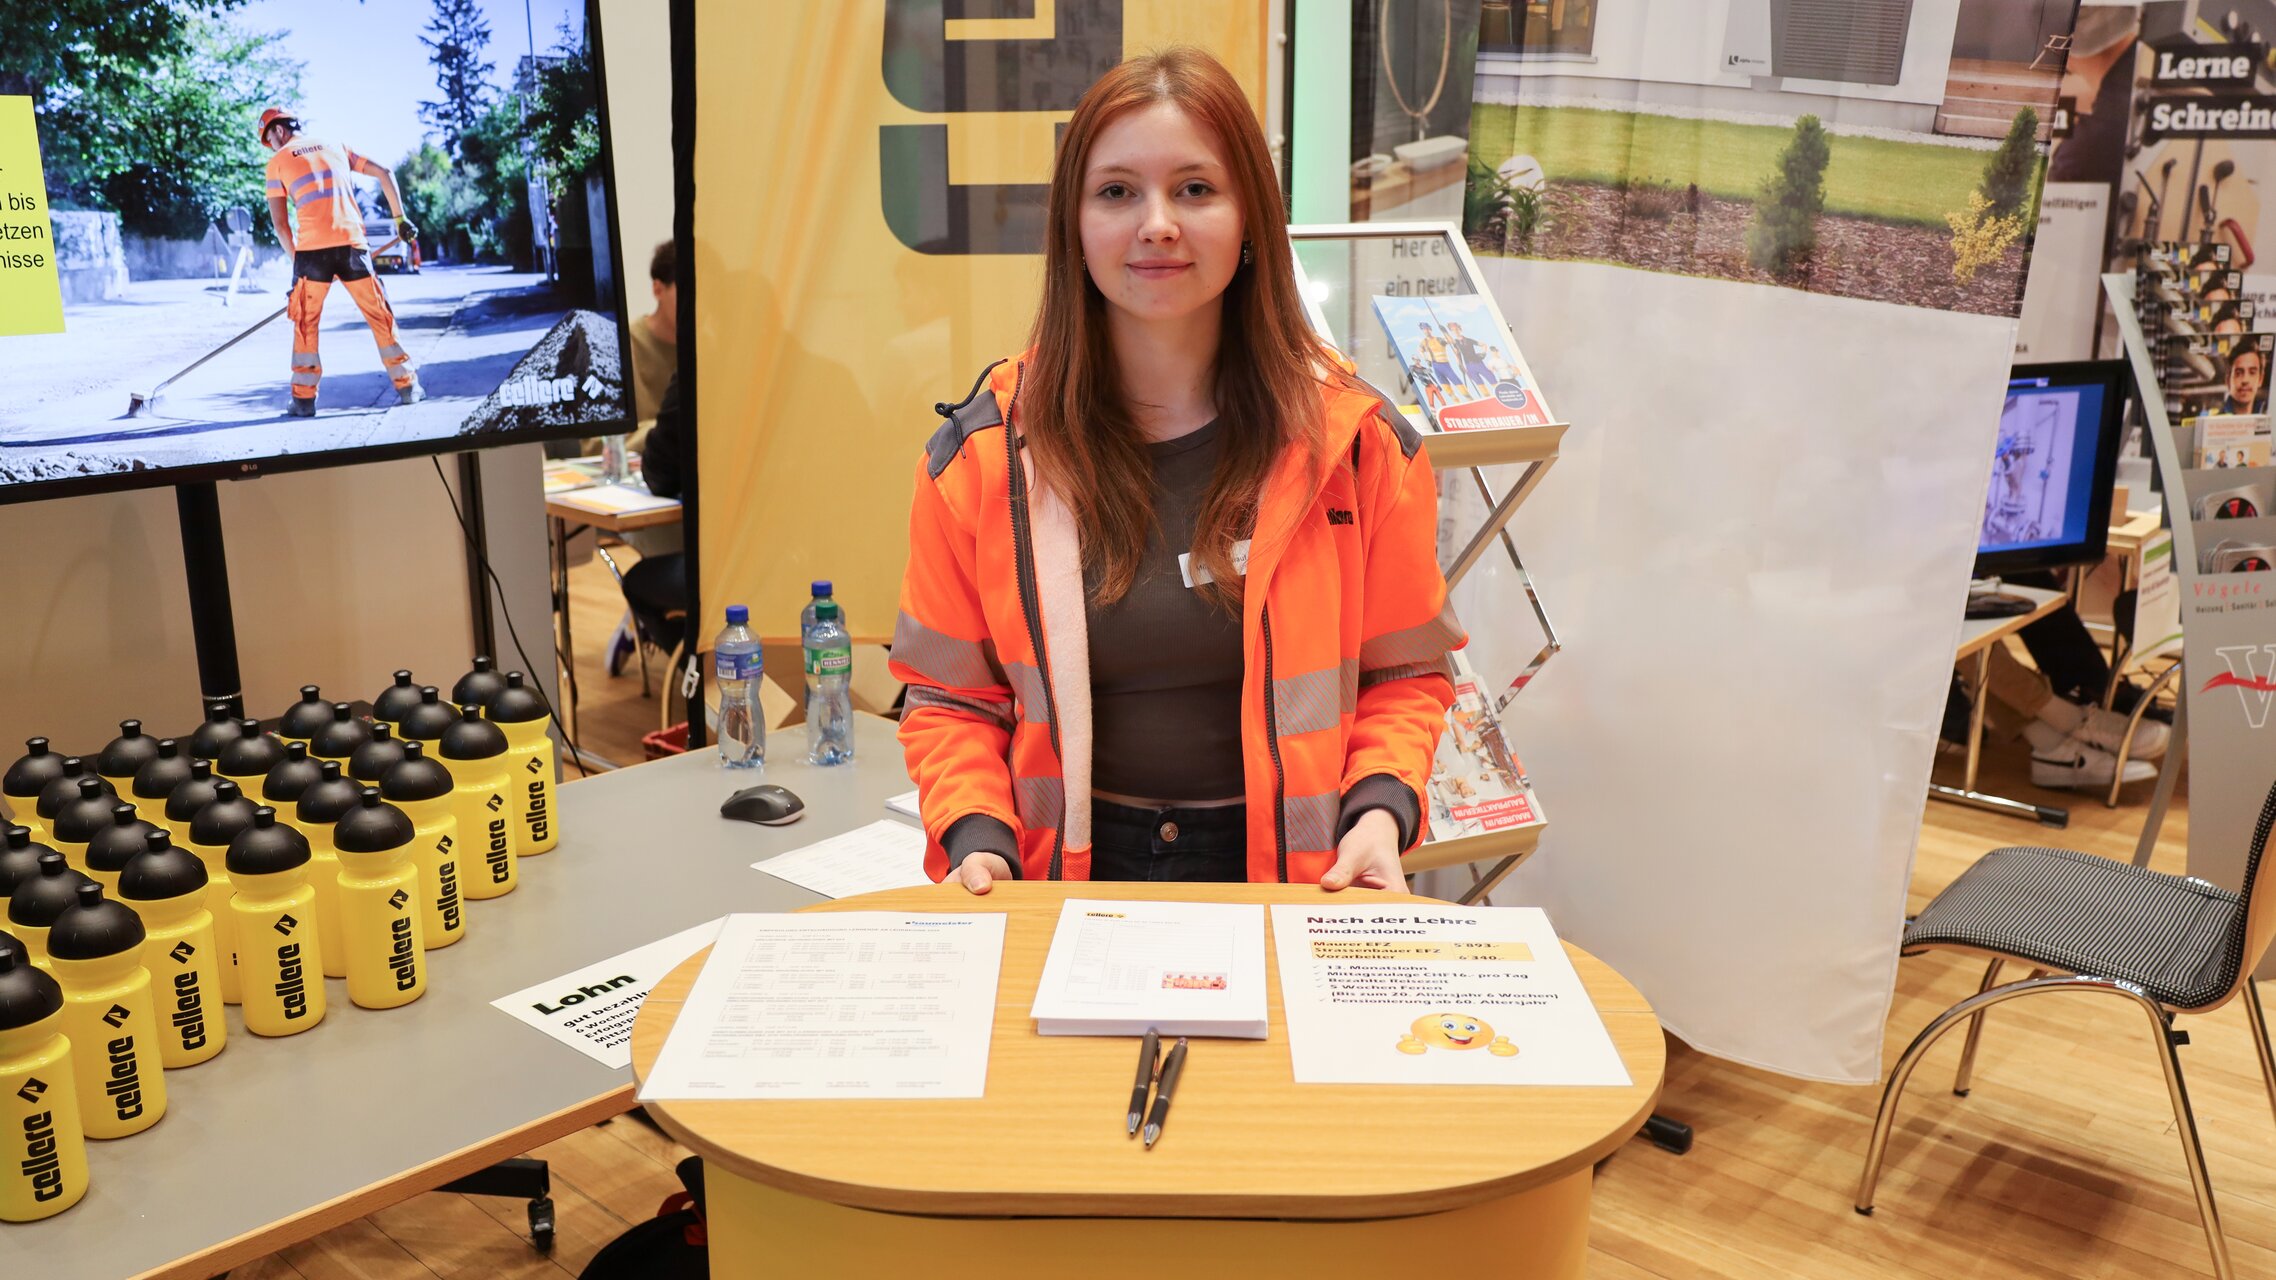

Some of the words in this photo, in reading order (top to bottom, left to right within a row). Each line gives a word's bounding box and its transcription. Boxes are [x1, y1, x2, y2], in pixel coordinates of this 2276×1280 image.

[2158, 53, 2250, 80] Lerne
[2152, 101, 2276, 131] Schrein
[8, 193, 36, 211] bis
[1391, 238, 1425, 259] Hier
[1384, 275, 1411, 297] ein
[500, 376, 575, 408] cellere
[1444, 413, 1540, 429] STRASSENBAUER/IN
[526, 780, 548, 843] cellere
[486, 818, 509, 884] cellere
[437, 861, 460, 932] cellere
[1414, 917, 1477, 925] Lehre
[389, 916, 416, 992] cellere
[275, 942, 307, 1021] cellere
[532, 974, 637, 1016] Lohn
[171, 970, 207, 1051] cellere
[563, 1013, 591, 1029] gut
[591, 989, 651, 1016] bezahlt
[585, 1008, 635, 1029] Wochen
[105, 1035, 143, 1121] cellere
[21, 1110, 63, 1203] cellere
